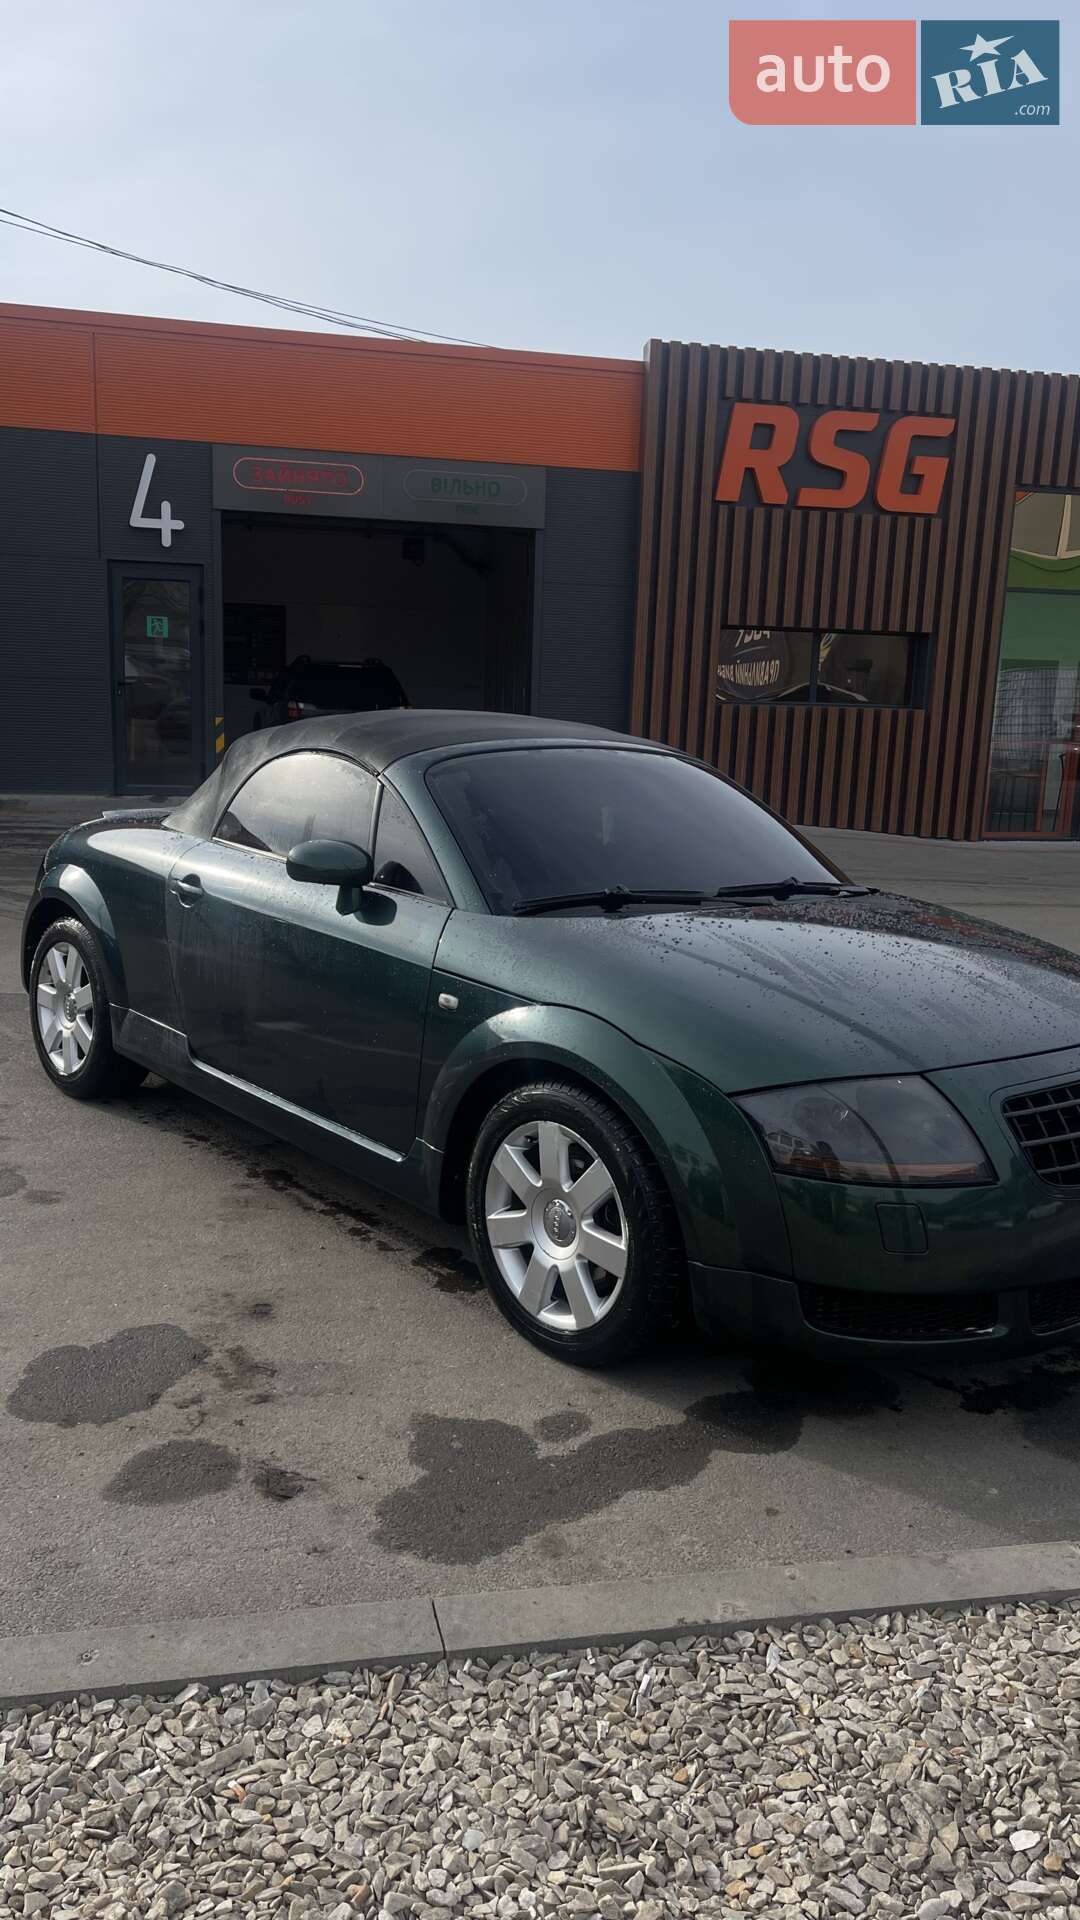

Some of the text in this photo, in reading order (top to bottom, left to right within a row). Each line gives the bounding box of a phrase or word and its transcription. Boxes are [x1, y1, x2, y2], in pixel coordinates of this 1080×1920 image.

[129, 454, 185, 546] 4
[430, 477, 501, 498] ВІЛЬНО
[715, 402, 956, 513] RSG
